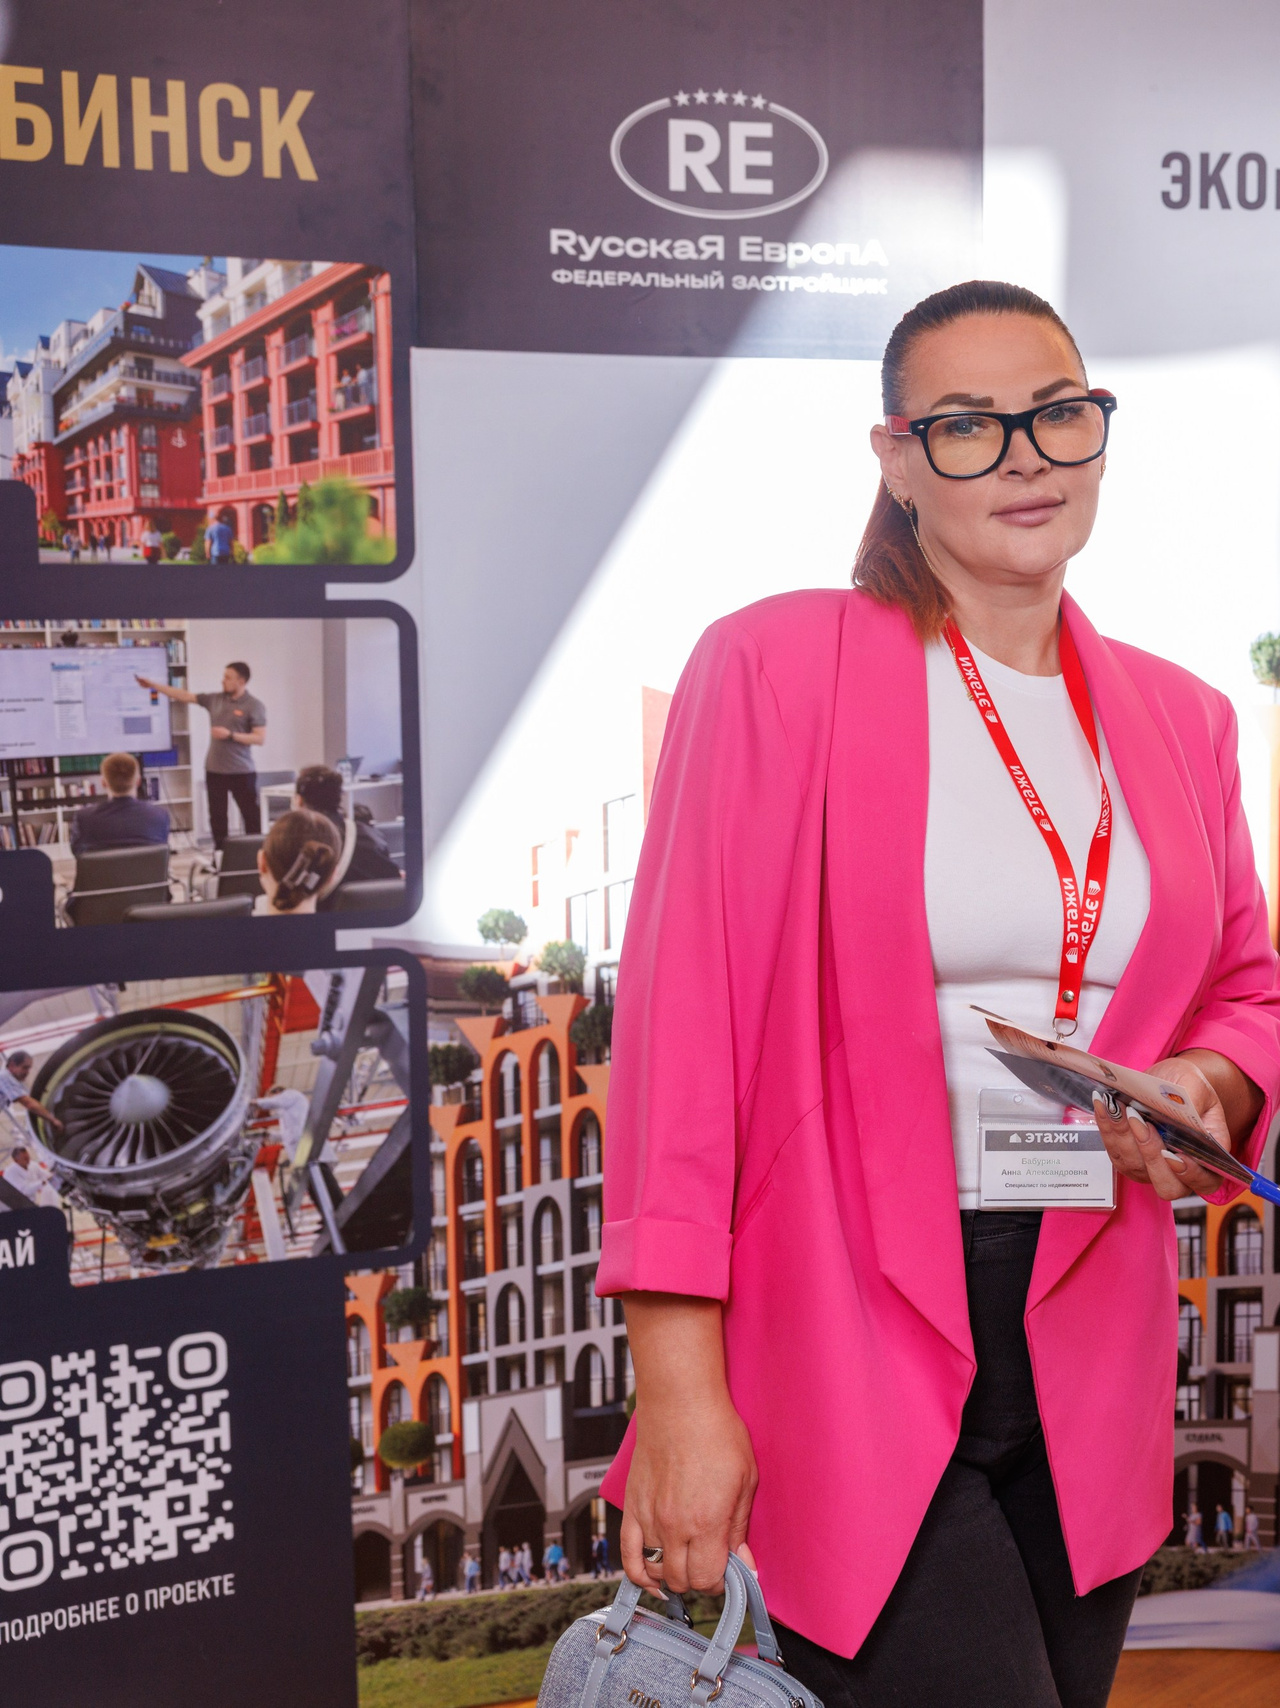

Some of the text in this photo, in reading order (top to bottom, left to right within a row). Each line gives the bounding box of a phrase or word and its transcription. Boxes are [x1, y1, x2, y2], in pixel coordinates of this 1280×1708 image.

[0, 64, 319, 182] БИНСК
[668, 118, 774, 195] RE
[551, 268, 725, 291] ФЕДЕРАЛЬНЫЙ
[1001, 1168, 1088, 1177] Анна Александровна
[1021, 1157, 1061, 1166] Бабурина
[0, 1573, 236, 1646] ПОДРОБНЕЕ О ПРОЕКТЕ
